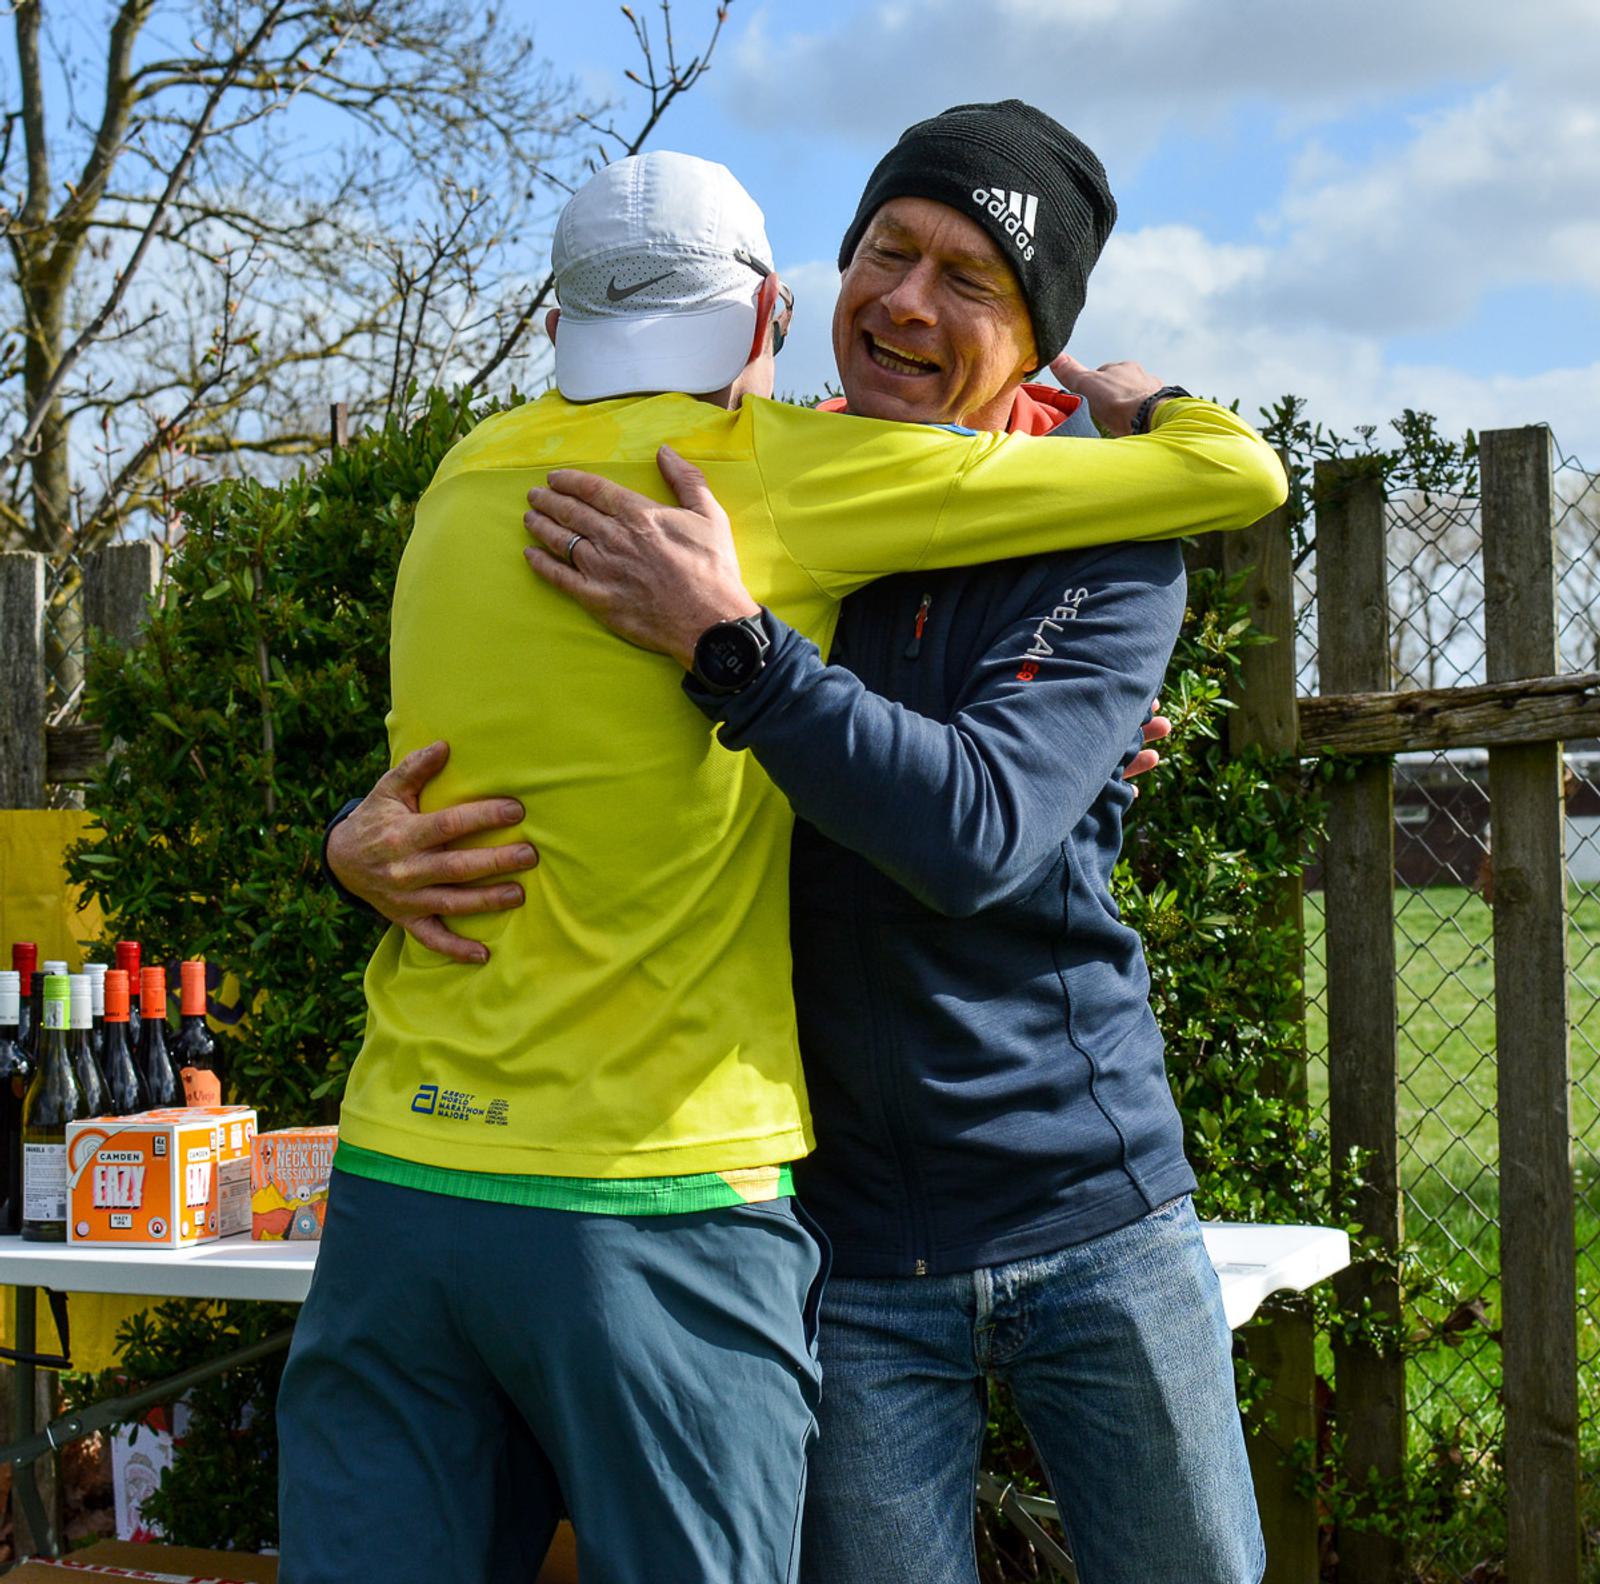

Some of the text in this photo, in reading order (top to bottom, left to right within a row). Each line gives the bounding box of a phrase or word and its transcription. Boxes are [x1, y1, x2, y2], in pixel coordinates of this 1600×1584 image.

[972, 189, 1034, 261] adidas
[438, 1102, 485, 1115] MARATHON
[438, 1110, 469, 1121] MAJORS
[99, 1153, 140, 1161] CAMDEN
[277, 1150, 330, 1168] NECK OIL
[277, 1167, 314, 1180] SESSION
[94, 1165, 146, 1209] EAZY
